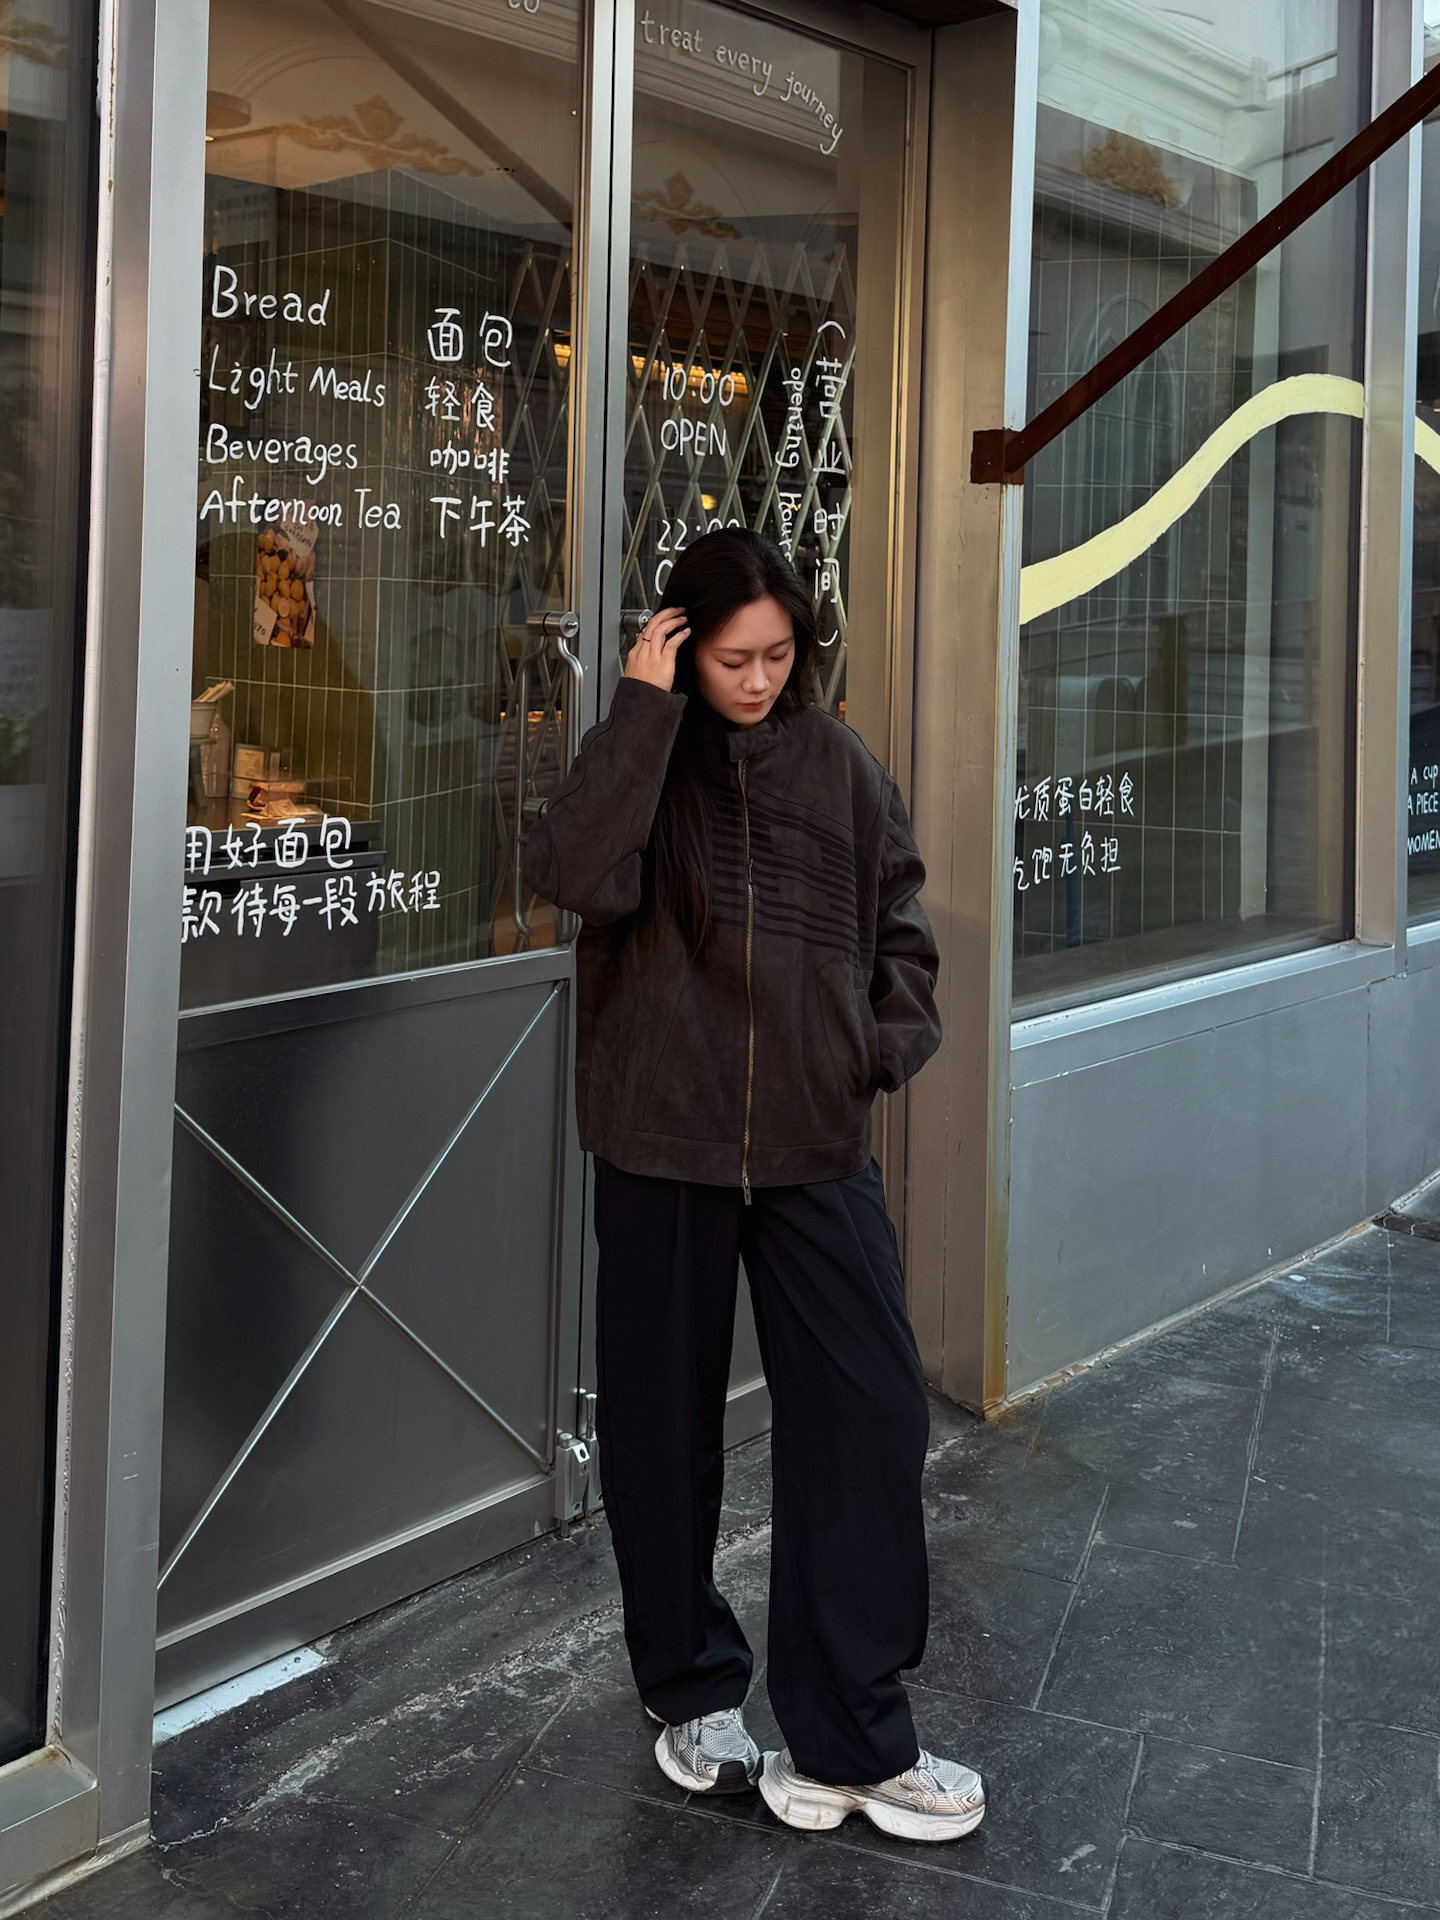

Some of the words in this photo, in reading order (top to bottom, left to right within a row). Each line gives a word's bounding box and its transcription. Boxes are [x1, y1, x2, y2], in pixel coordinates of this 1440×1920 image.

[640, 10, 704, 53] treat
[715, 45, 773, 96] every
[780, 71, 843, 155] journey
[211, 264, 331, 326] Bread
[427, 307, 513, 367] 面包
[208, 344, 299, 409] Light
[309, 366, 386, 407] Meals
[424, 376, 495, 432] 轻食
[662, 366, 735, 407] 10:00
[660, 418, 727, 457] OPEN
[775, 367, 805, 468] opening
[206, 423, 358, 485] Beverages
[430, 440, 511, 484] 咖啡
[199, 475, 344, 528] Afternoon
[354, 488, 402, 529] Tea
[429, 494, 532, 548] 下午茶
[657, 518, 740, 552] 22:
[1407, 794, 1414, 816] A
[1416, 792, 1439, 816] PIECE
[1410, 767, 1418, 785] A
[185, 813, 354, 876] 用好面包
[181, 868, 442, 943] 款待每一段旅程
